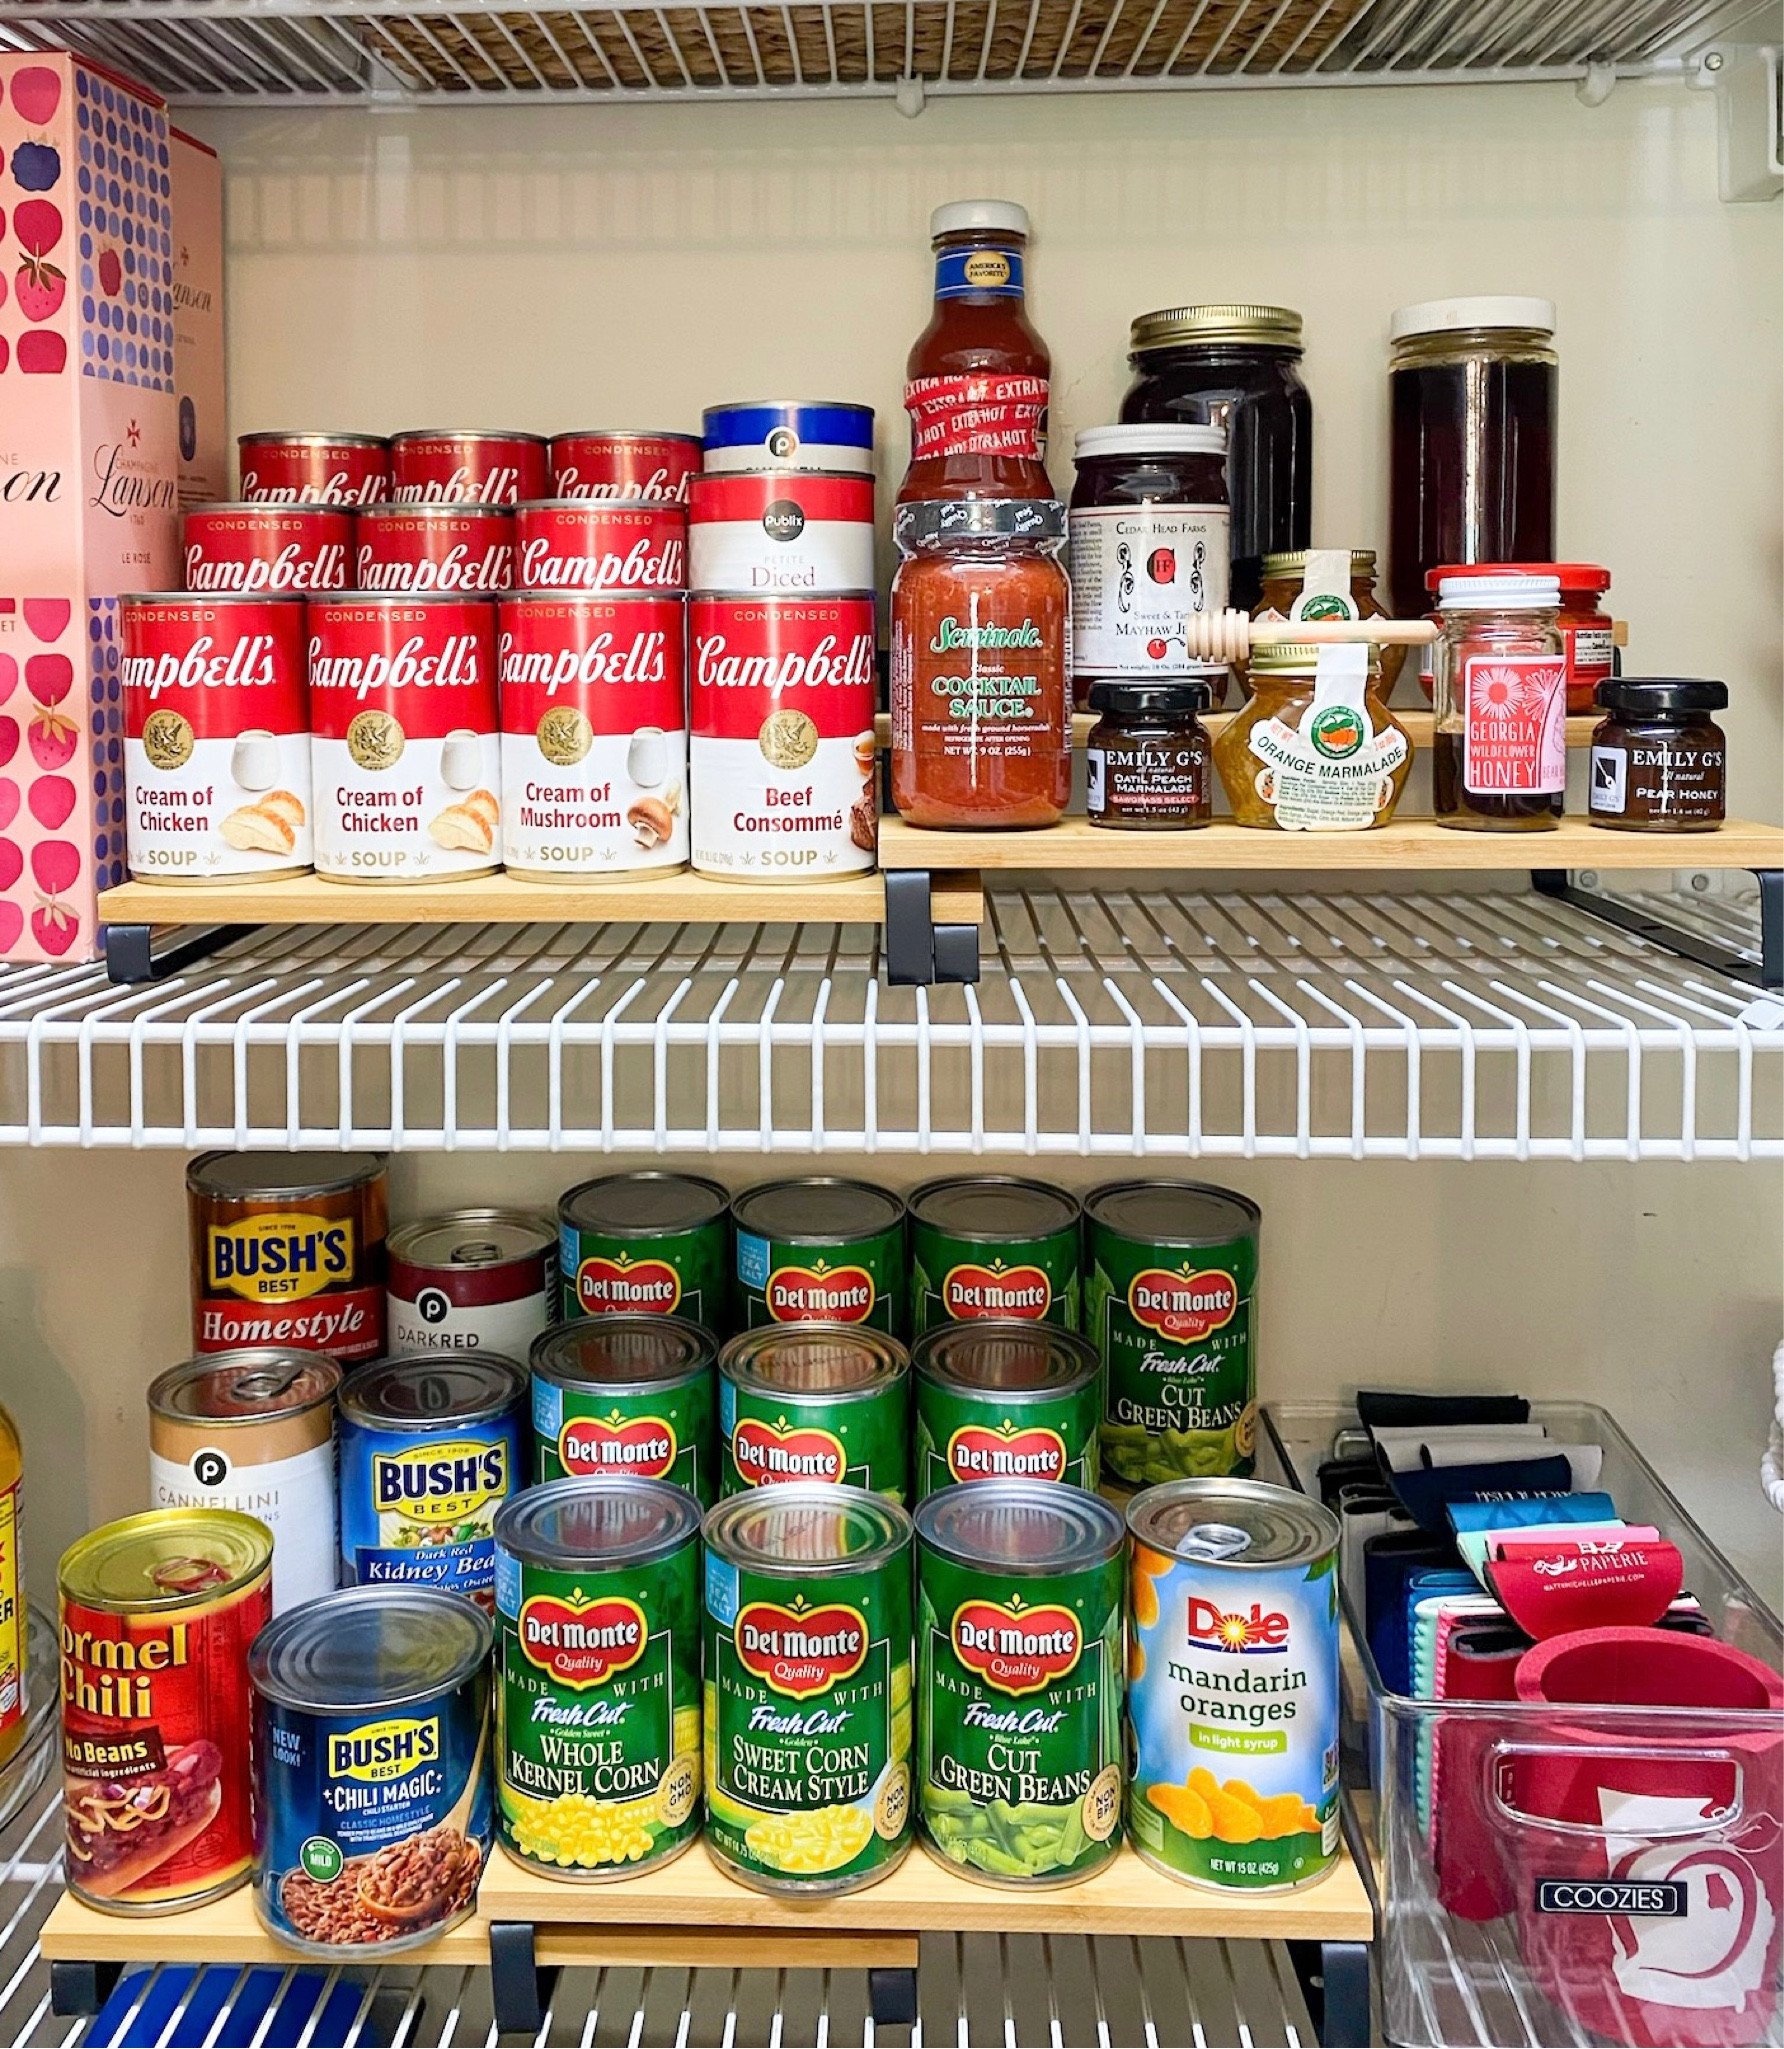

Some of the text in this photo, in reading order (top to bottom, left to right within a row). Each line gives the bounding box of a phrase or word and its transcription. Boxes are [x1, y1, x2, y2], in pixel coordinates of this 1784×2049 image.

[89, 444, 175, 517] Lanson
[206, 520, 303, 531] CONDENSED
[377, 521, 471, 532] CONDENSED
[556, 514, 653, 526] CONDENSED
[764, 515, 804, 528] Publix
[185, 543, 345, 593] Campbell's
[356, 543, 513, 593] Campbell's
[522, 538, 683, 591] Campbell's
[751, 566, 815, 588] Diced
[325, 610, 427, 622] CONDENSED
[517, 606, 616, 618] CONDENSED
[733, 609, 839, 622] CONDENSED
[696, 634, 873, 699] Campbell's
[931, 676, 1043, 696] COCKTAIL
[949, 697, 1025, 718] SAUCE
[1470, 721, 1536, 743] GEORGIA
[944, 746, 962, 756] NET
[1106, 750, 1203, 767] EMILY G'S
[1257, 736, 1403, 778] ORANGE MARMALADE
[1470, 745, 1536, 758] WILDFLOWER
[1632, 749, 1722, 767] EMILY G'S
[1152, 774, 1192, 784] PEACH
[1470, 760, 1536, 787] HONEY
[136, 785, 214, 807] Cream of
[336, 786, 424, 807] Cream of
[526, 782, 611, 802] Cream of
[765, 786, 813, 807] Beef
[1116, 784, 1193, 794] MARMALADE
[1636, 787, 1719, 800] PEAR HONEY
[140, 811, 209, 832] Chicken
[341, 812, 419, 833] Chicken
[520, 807, 621, 828] Mushroom
[733, 811, 842, 833] Consommé
[148, 851, 198, 866] SOUP
[351, 851, 407, 867] SOUP
[539, 846, 594, 861] SOUP
[760, 851, 818, 866] SOUP
[214, 1228, 347, 1279] BUSH'S
[258, 1278, 299, 1293] BEST
[582, 1274, 674, 1302] Del Monte
[951, 1282, 1045, 1309] Del Monte
[773, 1284, 869, 1310] Del Monte
[1136, 1287, 1232, 1312] Del Monte
[203, 1302, 366, 1344] Homestyle
[1164, 1314, 1205, 1332] Quality
[1113, 1329, 1247, 1350] MADE WITH
[1140, 1352, 1187, 1374] Fresh
[1160, 1384, 1206, 1407] CUT
[1118, 1397, 1242, 1429] GREEN BEANS
[566, 1436, 669, 1465] Del Monte
[738, 1436, 838, 1476] Del Monte
[956, 1444, 1059, 1475] Del Monte
[380, 1449, 503, 1503] BUSH'S
[414, 1499, 473, 1514] BEST
[369, 1554, 495, 1582] Kidney Bea
[1579, 1550, 1649, 1572] PAPERIE
[1188, 1596, 1289, 1645] Dole
[526, 1616, 639, 1650] Del Monte
[743, 1624, 860, 1658] Del Monte
[959, 1620, 1075, 1656] Del Monte
[61, 1623, 188, 1671] ormel
[554, 1652, 604, 1672] Quality
[774, 1661, 825, 1682] Quality
[990, 1657, 1041, 1679] Quality
[61, 1656, 151, 1719] Chili
[507, 1667, 664, 1697] MADE WITH
[1168, 1660, 1307, 1693] mandarin
[721, 1678, 884, 1706] MADE WITH
[935, 1670, 1097, 1706] MADE WITH
[531, 1697, 583, 1724] Fresh
[748, 1705, 803, 1734] Fresh
[963, 1701, 1018, 1731] Fresh
[1181, 1694, 1296, 1727] oranges
[272, 1726, 301, 1748] NEW
[1198, 1730, 1279, 1751] in light syrup
[83, 1741, 148, 1763] Beans
[272, 1748, 301, 1767] LOOK!
[334, 1725, 435, 1772] BUSH'S
[540, 1734, 625, 1767] WHOLE
[733, 1734, 869, 1775] SWEET CORN
[987, 1742, 1042, 1775] CUT
[371, 1764, 401, 1779] BEST
[511, 1750, 660, 1795] KERNEL CORN
[940, 1754, 1091, 1802] GREEN BEANS
[334, 1770, 435, 1812] CHILI MAGIC
[733, 1765, 870, 1802] CREAM STYLE
[340, 1819, 378, 1830] CLASSIC
[380, 1804, 431, 1827] HOMESTYLE
[309, 1853, 333, 1867] MILD
[1210, 1858, 1224, 1871] NET
[1224, 1860, 1237, 1873] WT
[1237, 1861, 1246, 1874] 15
[1554, 1886, 1664, 1910] COOZIES
